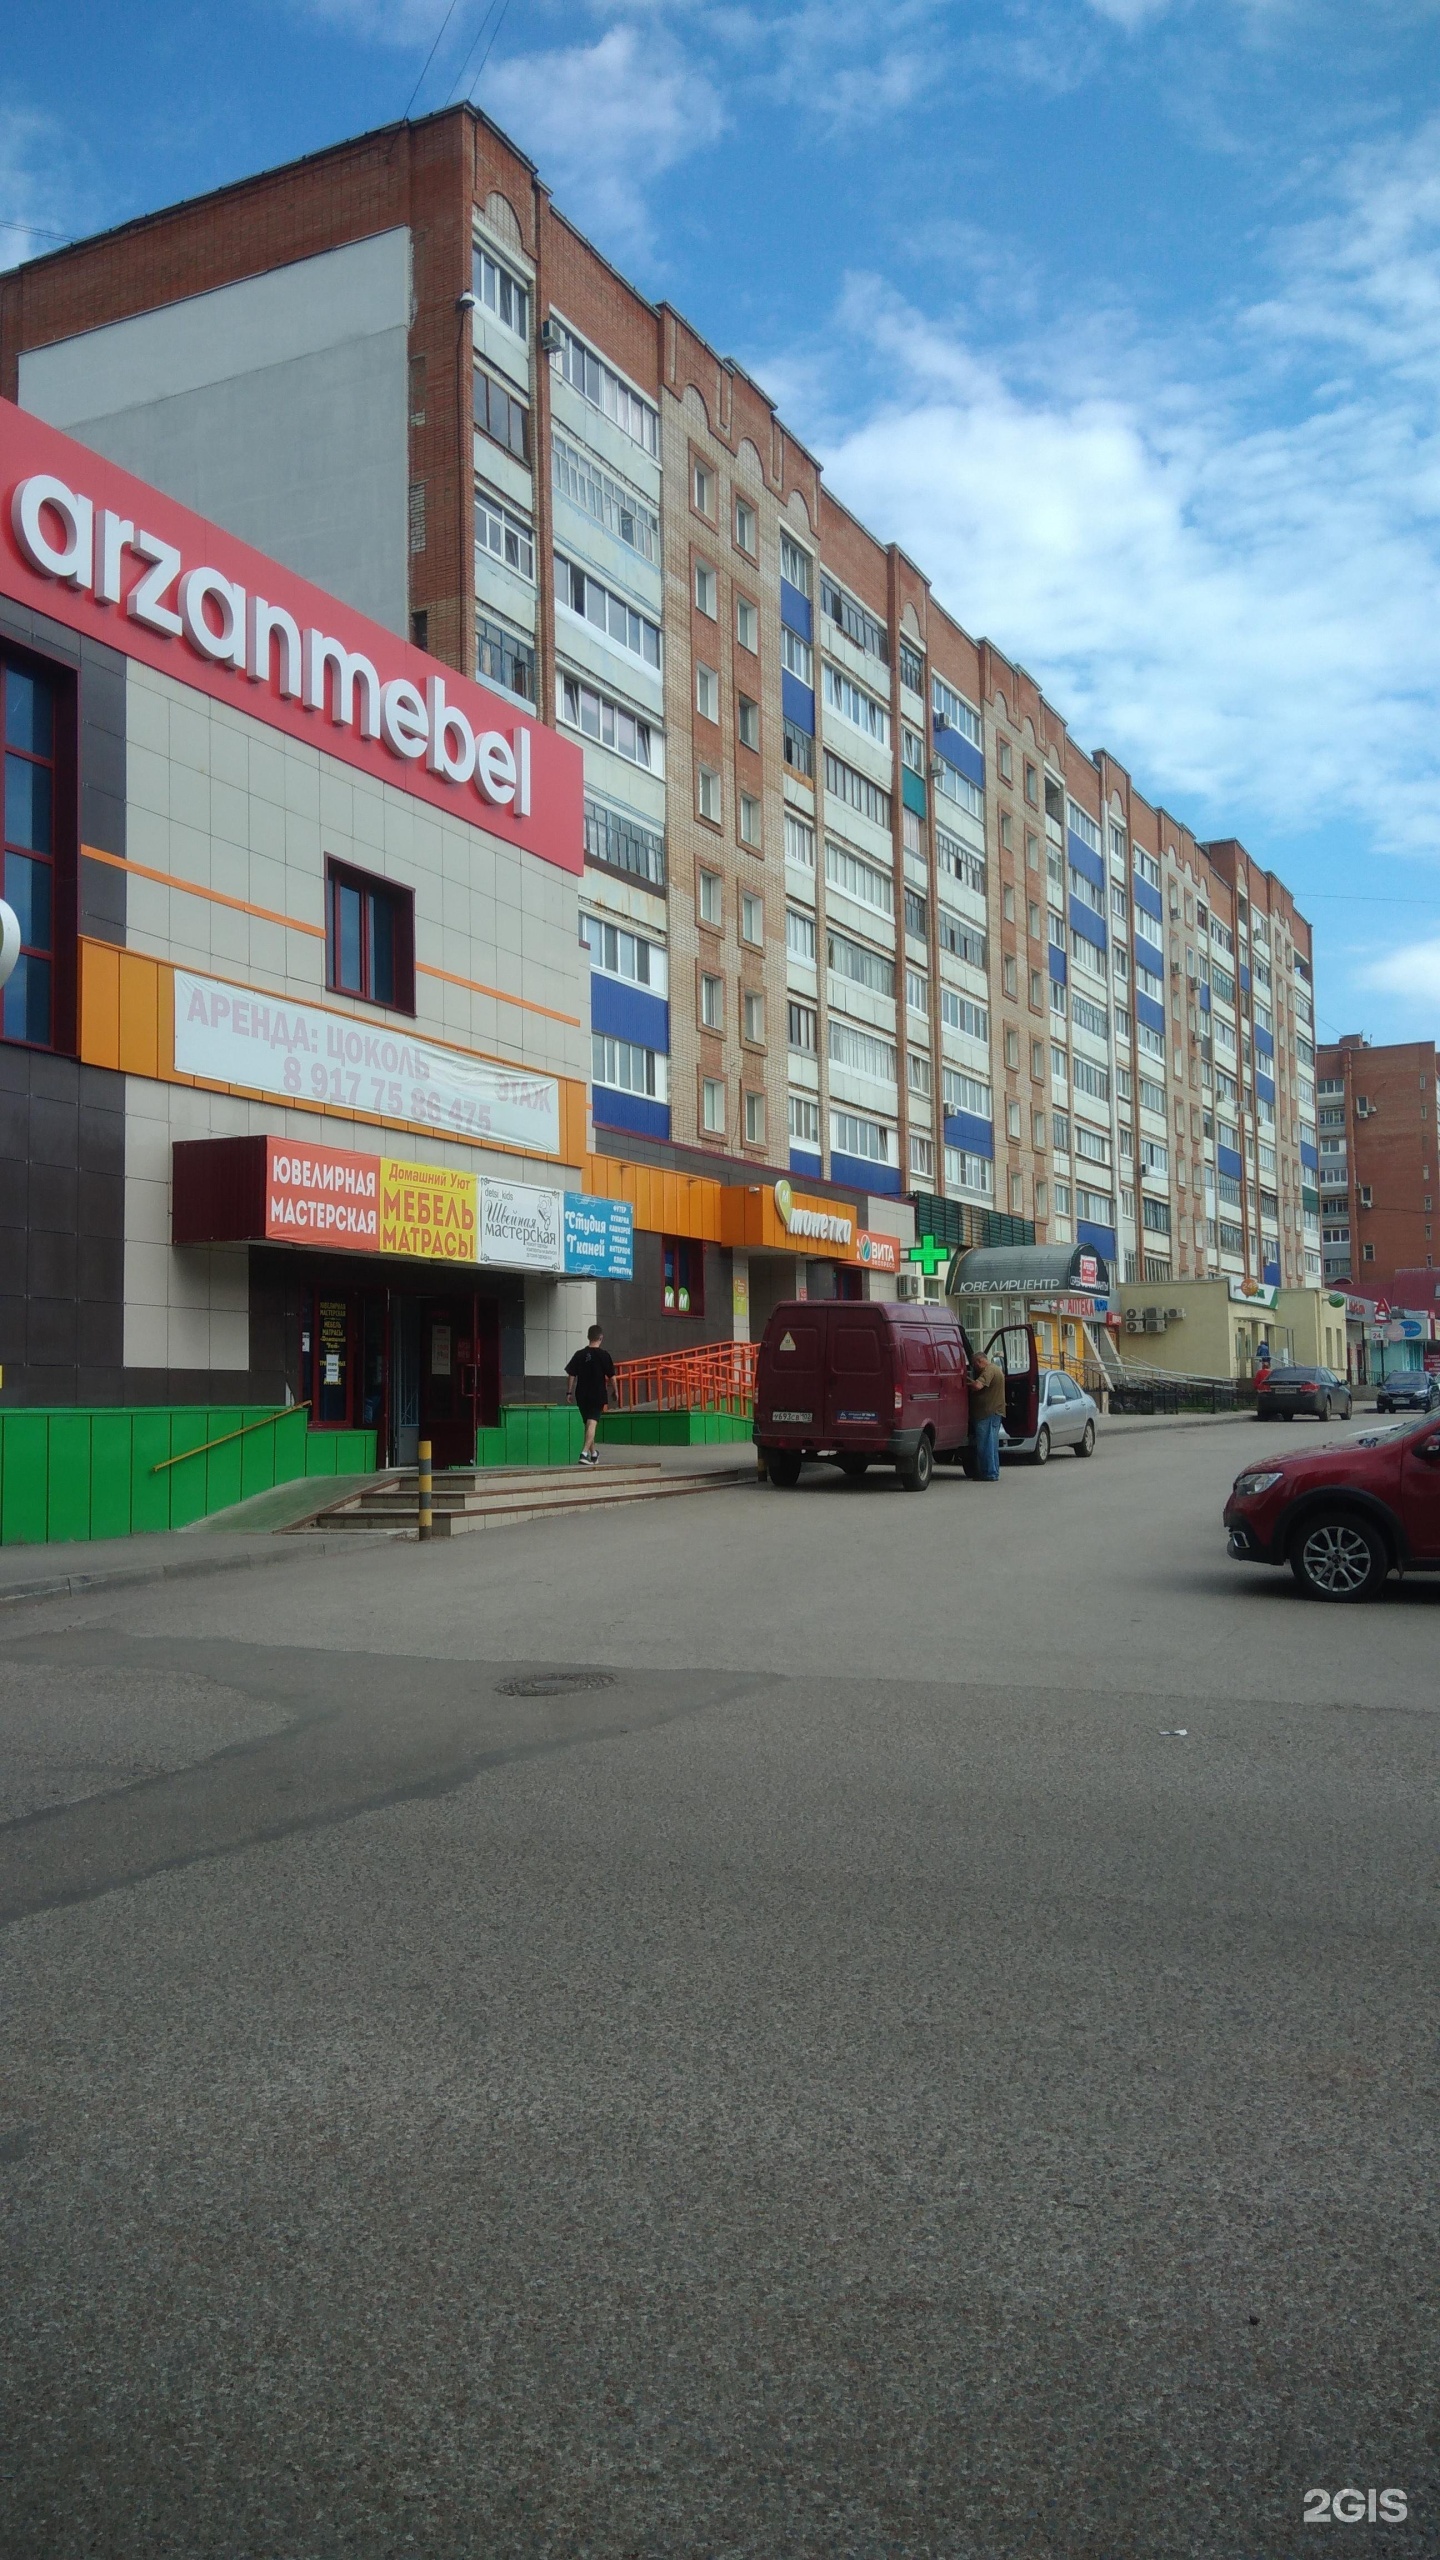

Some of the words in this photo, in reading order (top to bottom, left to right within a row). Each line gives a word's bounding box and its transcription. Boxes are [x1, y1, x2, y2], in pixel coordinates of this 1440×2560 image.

[11, 474, 531, 818] arzanmebel
[187, 988, 318, 1054] АРЕНДА:
[327, 1025, 430, 1081] ЦОКОЛЬ
[494, 1074, 552, 1114] ЭТАЖ
[283, 1056, 301, 1093] 8
[311, 1062, 361, 1105] 917
[370, 1077, 403, 1116] 75
[410, 1087, 441, 1122] 86
[448, 1097, 492, 1136] 475
[273, 1155, 376, 1198] ЮВЕЛИРНАЯ
[389, 1163, 447, 1187] Домашний
[450, 1173, 471, 1191] Уют
[271, 1196, 377, 1235] МАСТЕРСКАЯ
[383, 1187, 474, 1231] МЕБЕЛЬ
[484, 1199, 537, 1229] Швейная
[565, 1210, 607, 1236] Студия
[382, 1223, 474, 1260] МАТРАСЫ
[566, 1233, 606, 1257] Тканей
[871, 1241, 895, 1263] ВИТА
[959, 1278, 1060, 1293] ЮВЕЛИРЦЕНТР
[1067, 1298, 1096, 1317] АПТЕКА
[1372, 1332, 1382, 1340] 24
